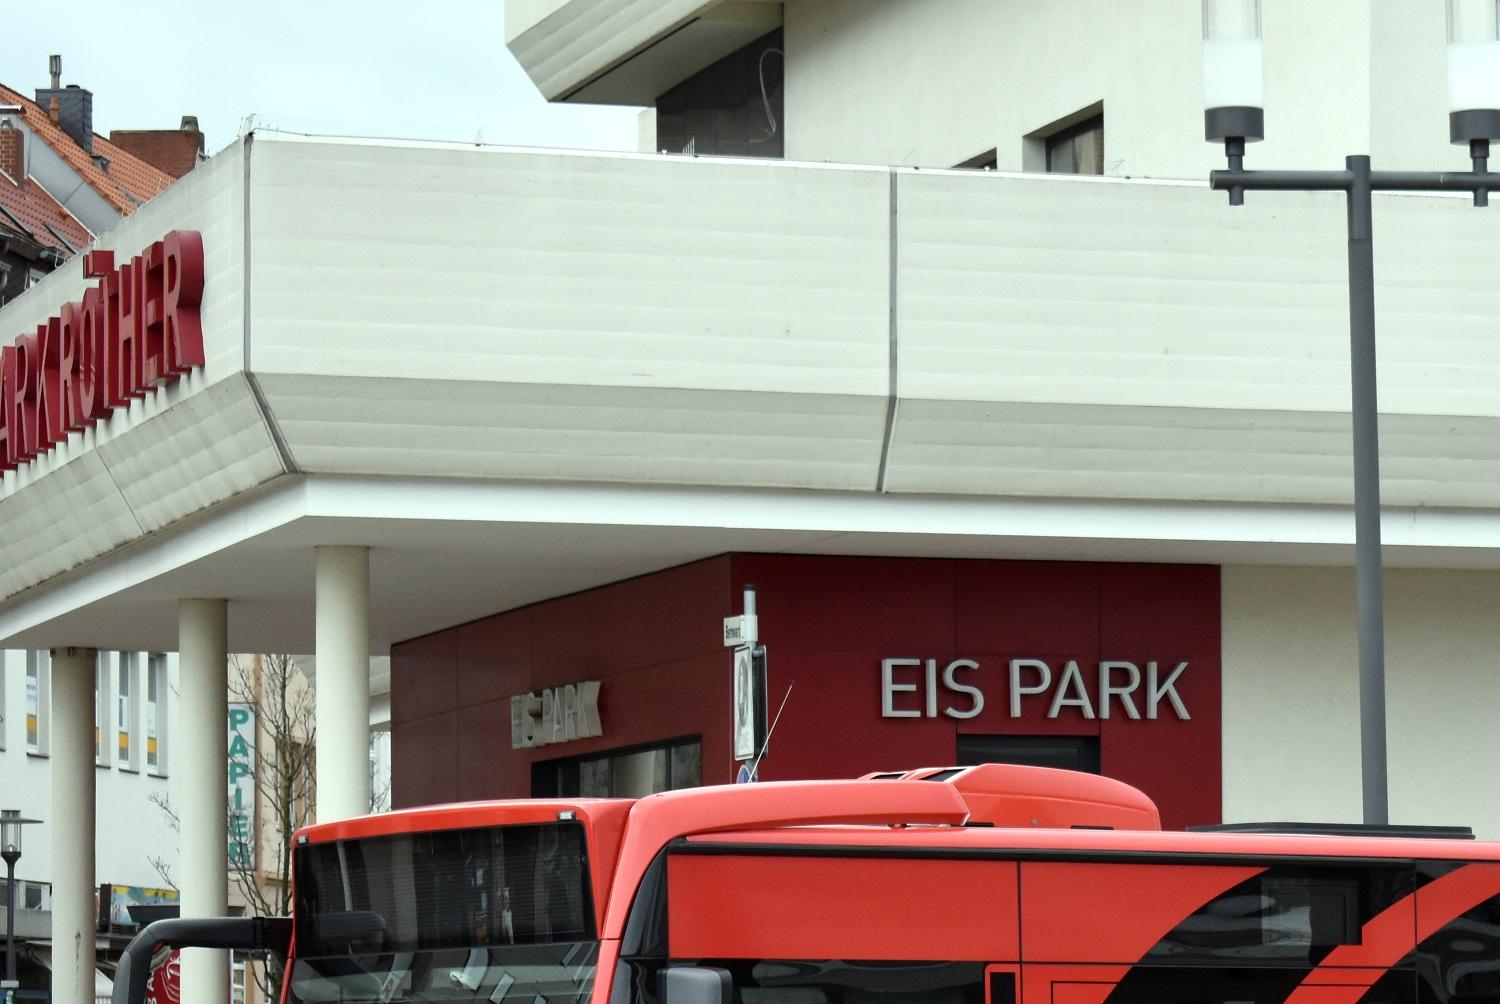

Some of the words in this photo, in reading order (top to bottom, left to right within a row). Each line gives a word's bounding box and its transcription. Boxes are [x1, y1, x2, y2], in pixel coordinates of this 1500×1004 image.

[511, 692, 536, 750] EIS
[543, 681, 602, 743] PARK
[882, 658, 985, 719] EIS
[1009, 659, 1191, 720] PARK
[228, 709, 249, 864] PAPIER
